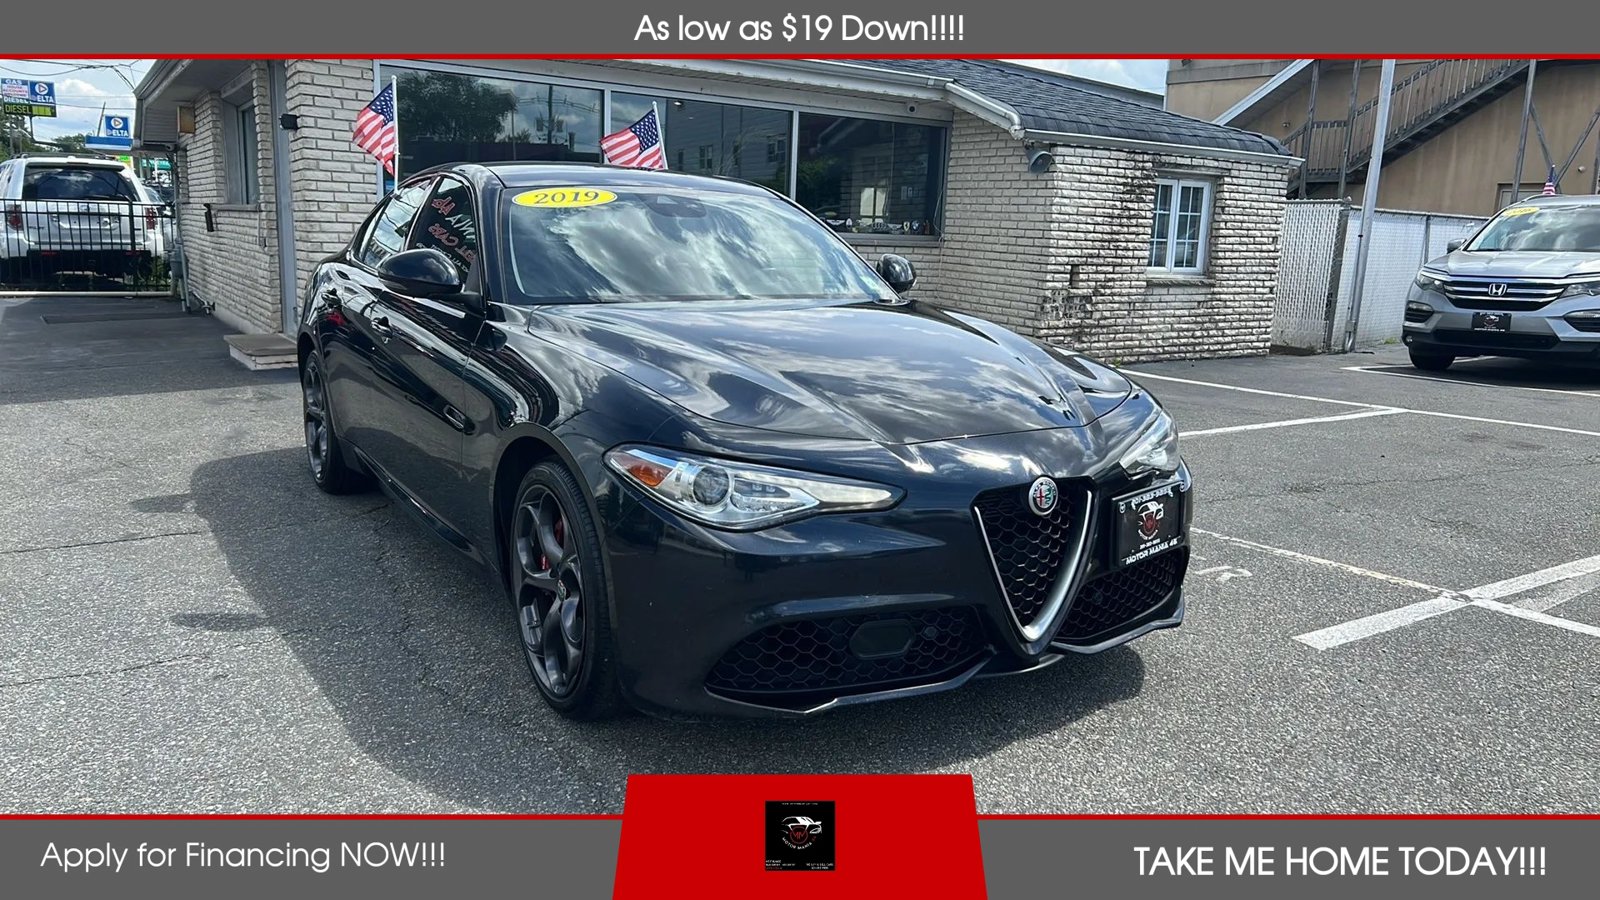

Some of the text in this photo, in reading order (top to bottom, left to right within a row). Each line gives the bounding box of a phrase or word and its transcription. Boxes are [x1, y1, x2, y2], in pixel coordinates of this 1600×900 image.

[5, 104, 31, 114] DIESEL
[534, 191, 599, 204] 2019
[1126, 550, 1148, 565] MOTOR
[1149, 541, 1168, 555] MANIA
